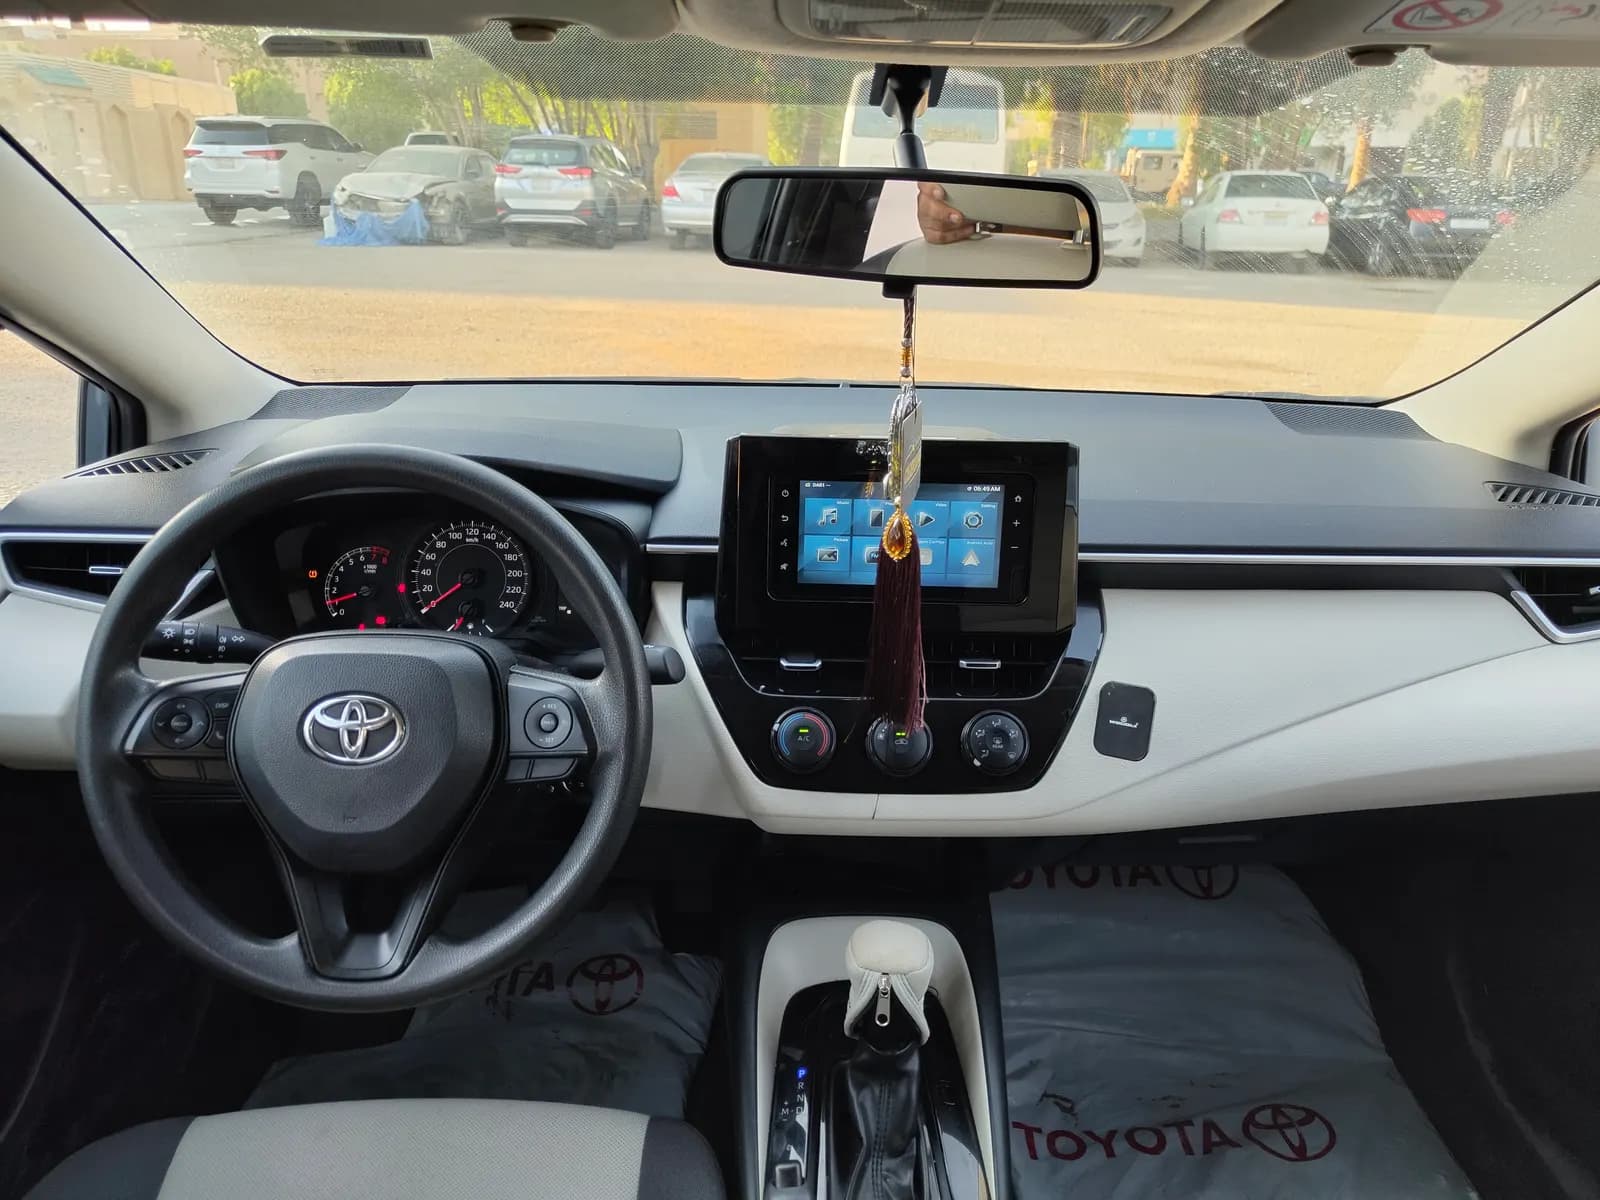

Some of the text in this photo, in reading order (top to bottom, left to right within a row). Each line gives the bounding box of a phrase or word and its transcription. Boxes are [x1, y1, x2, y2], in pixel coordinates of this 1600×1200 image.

[448, 532, 463, 540] 100
[465, 528, 480, 536] 120
[482, 533, 497, 541] 140
[435, 541, 447, 549] 80
[495, 542, 509, 550] 160
[425, 553, 437, 561] 60
[420, 568, 432, 576] 40
[507, 570, 523, 578] 200
[331, 586, 337, 594] 2
[505, 586, 522, 594] 220
[499, 601, 515, 609] 240
[339, 608, 345, 616] 0
[1006, 863, 1162, 890] OYOTA
[797, 1069, 806, 1079] P
[798, 1081, 805, 1090] R
[796, 1094, 805, 1102] N
[781, 1107, 790, 1116] M
[1012, 1119, 1243, 1161] TOYOTA
